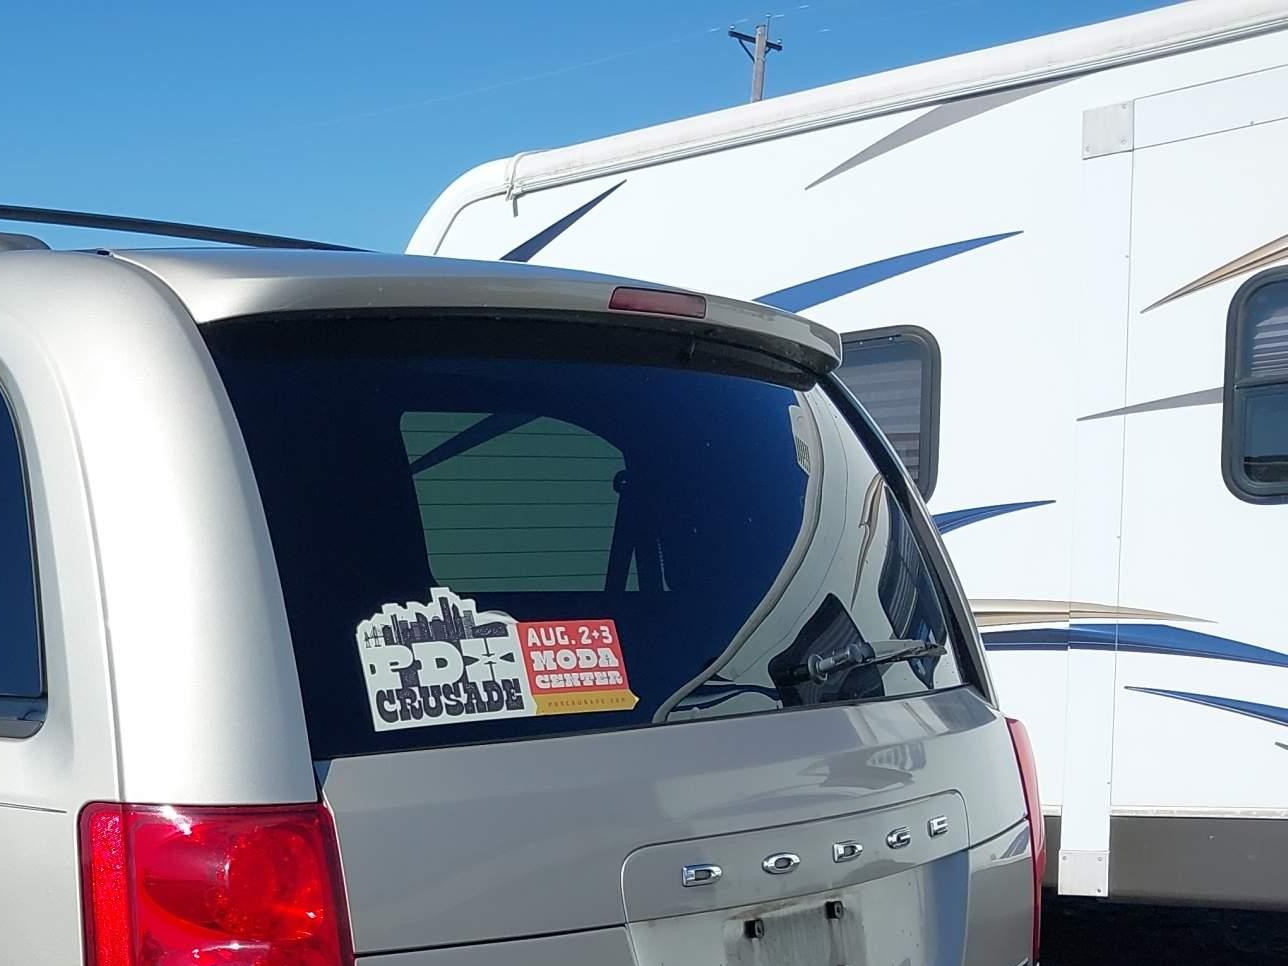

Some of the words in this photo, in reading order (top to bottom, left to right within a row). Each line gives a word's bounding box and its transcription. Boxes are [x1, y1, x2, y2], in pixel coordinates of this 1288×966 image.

[527, 626, 577, 647] AUG.
[578, 625, 613, 645] 2+3
[363, 637, 517, 690] PDX
[530, 647, 620, 672] MODA
[535, 670, 624, 690] CENTER
[375, 677, 525, 723] CRUSADE
[682, 814, 949, 888] DODGE
